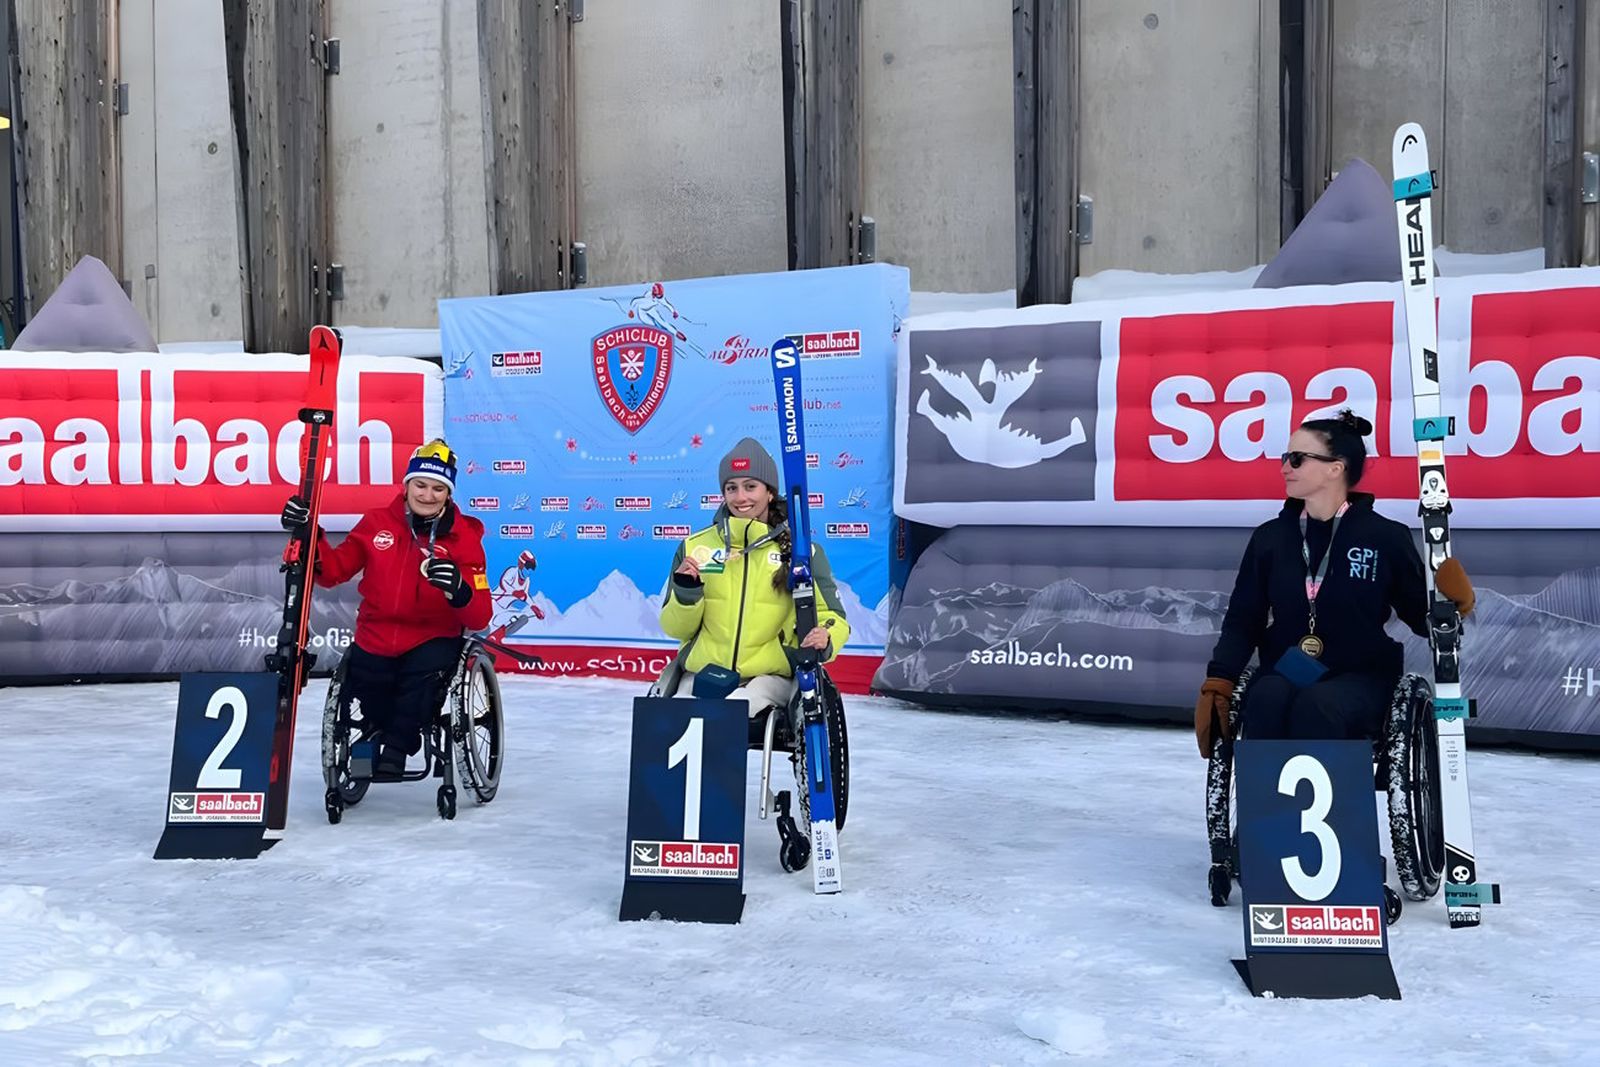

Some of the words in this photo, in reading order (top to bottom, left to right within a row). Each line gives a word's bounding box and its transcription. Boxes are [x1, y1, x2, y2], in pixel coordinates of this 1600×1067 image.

[1406, 197, 1427, 286] HEA
[596, 329, 667, 351] SCHICLUB
[806, 332, 857, 350] saalbach
[596, 356, 626, 420] Saalbach
[783, 377, 798, 444] SALOMON
[1347, 547, 1374, 563] GP
[1350, 562, 1370, 579] RT
[969, 640, 1134, 672] saalbach.com
[196, 686, 248, 789] 2
[667, 717, 705, 841] 1
[198, 794, 258, 811] saalbach
[1277, 754, 1342, 902] 3
[664, 843, 734, 865] saalbach
[1290, 907, 1375, 931] saalbach
